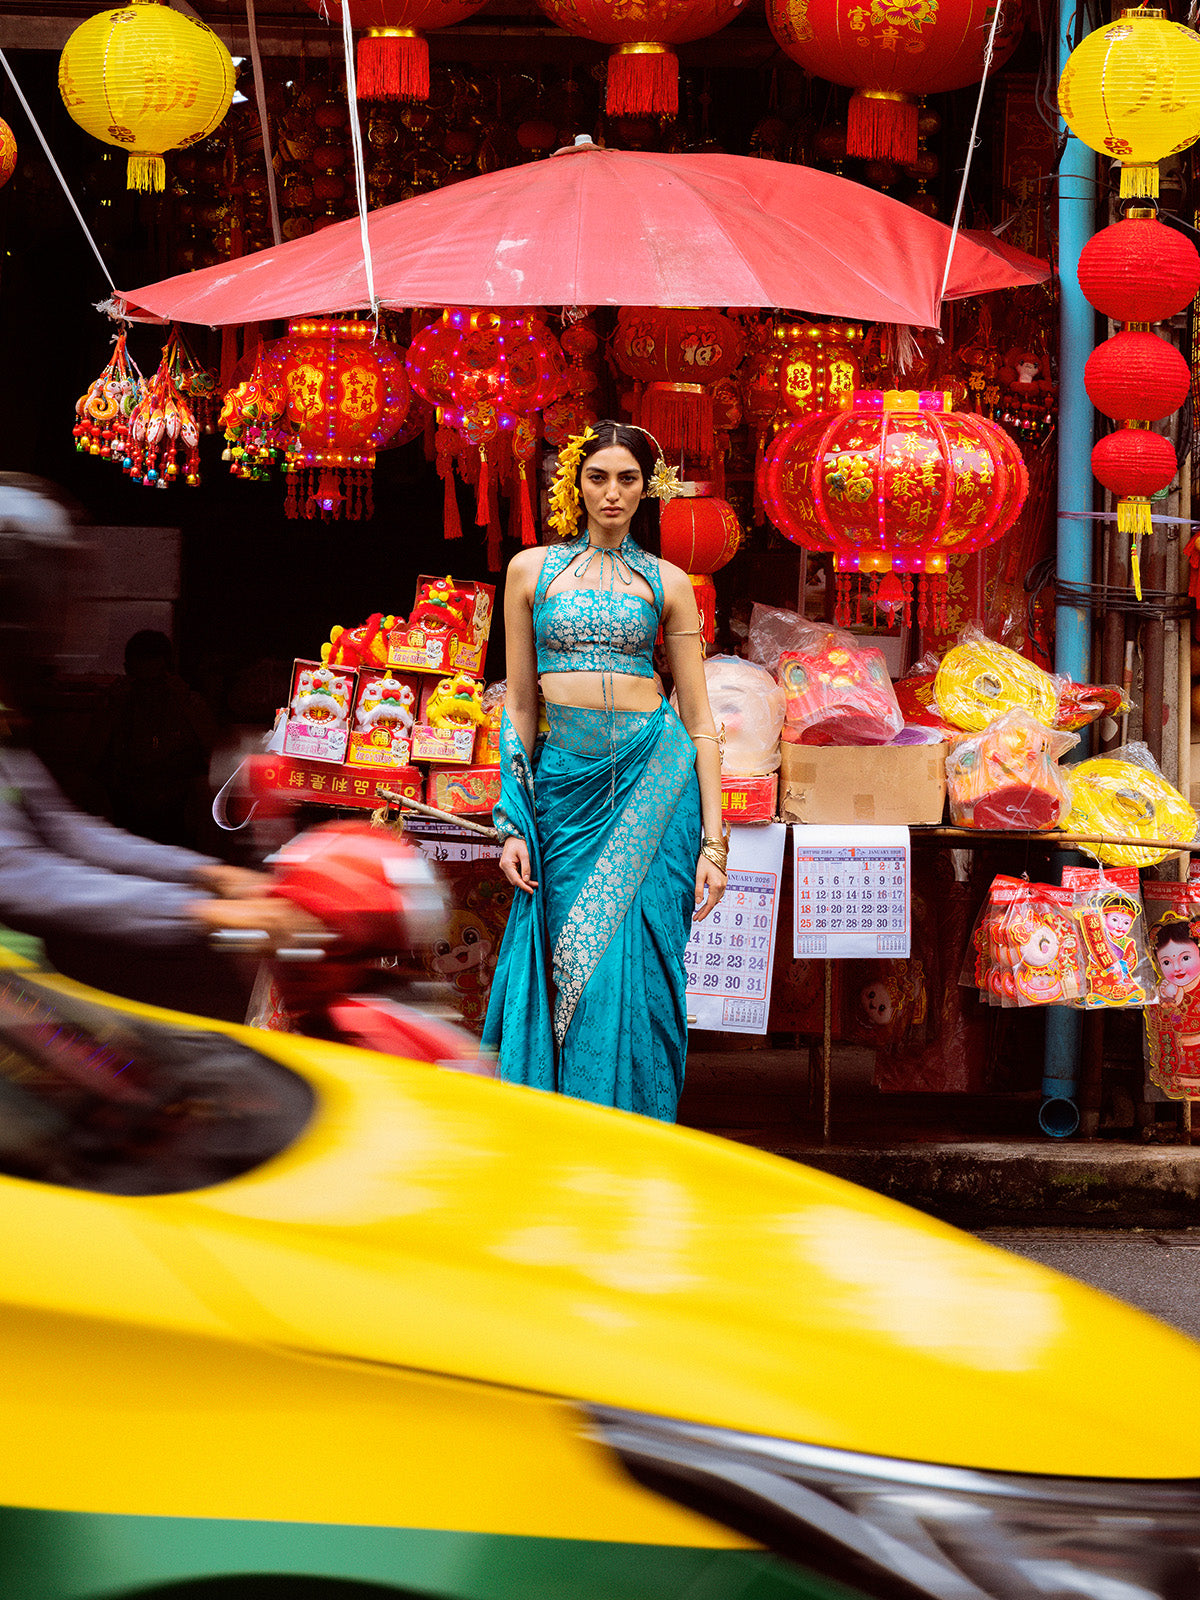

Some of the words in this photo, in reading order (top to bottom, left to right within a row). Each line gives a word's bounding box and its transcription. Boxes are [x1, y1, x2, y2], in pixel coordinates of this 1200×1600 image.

[680, 325, 722, 366] 福
[347, 371, 362, 404] 恭喜
[360, 382, 374, 412] 发财
[826, 454, 874, 504] 福
[374, 732, 388, 745] 福
[460, 848, 467, 859] 9
[727, 874, 754, 882] ANUARY
[803, 876, 808, 885] 4
[818, 876, 824, 885] 5
[834, 876, 839, 885] 6
[849, 876, 854, 885] 7
[864, 876, 870, 885] 8
[880, 876, 885, 885] 9
[892, 876, 902, 885] 10
[737, 893, 745, 905] 2
[758, 895, 766, 907] 3
[801, 891, 811, 899] 11
[816, 891, 826, 899] 12
[831, 891, 841, 899] 13
[846, 891, 856, 899] 14
[862, 891, 872, 899] 15
[877, 891, 887, 899] 16
[892, 891, 902, 899] 17
[801, 905, 811, 913] 18
[816, 905, 826, 913] 19
[831, 905, 842, 913] 20
[846, 905, 856, 913] 21
[862, 905, 872, 913] 22
[877, 905, 888, 913] 23
[892, 905, 903, 913] 24
[713, 912, 721, 924] 8
[735, 913, 742, 926] 9
[753, 915, 767, 928] 10
[800, 919, 811, 928] 25
[816, 919, 826, 928] 26
[831, 919, 842, 928] 27
[846, 919, 857, 928] 28
[861, 919, 872, 928] 29
[877, 919, 887, 928] 30
[892, 919, 902, 928] 31
[707, 932, 722, 945] 15
[729, 934, 744, 947] 16
[751, 936, 766, 949] 17
[1054, 916, 1077, 980] 大吉大利
[684, 952, 699, 964] 21
[705, 953, 721, 966] 22
[727, 955, 742, 968] 23
[749, 957, 764, 970] 24
[703, 974, 719, 987] 29
[725, 976, 740, 989] 30
[747, 978, 762, 991] 31
